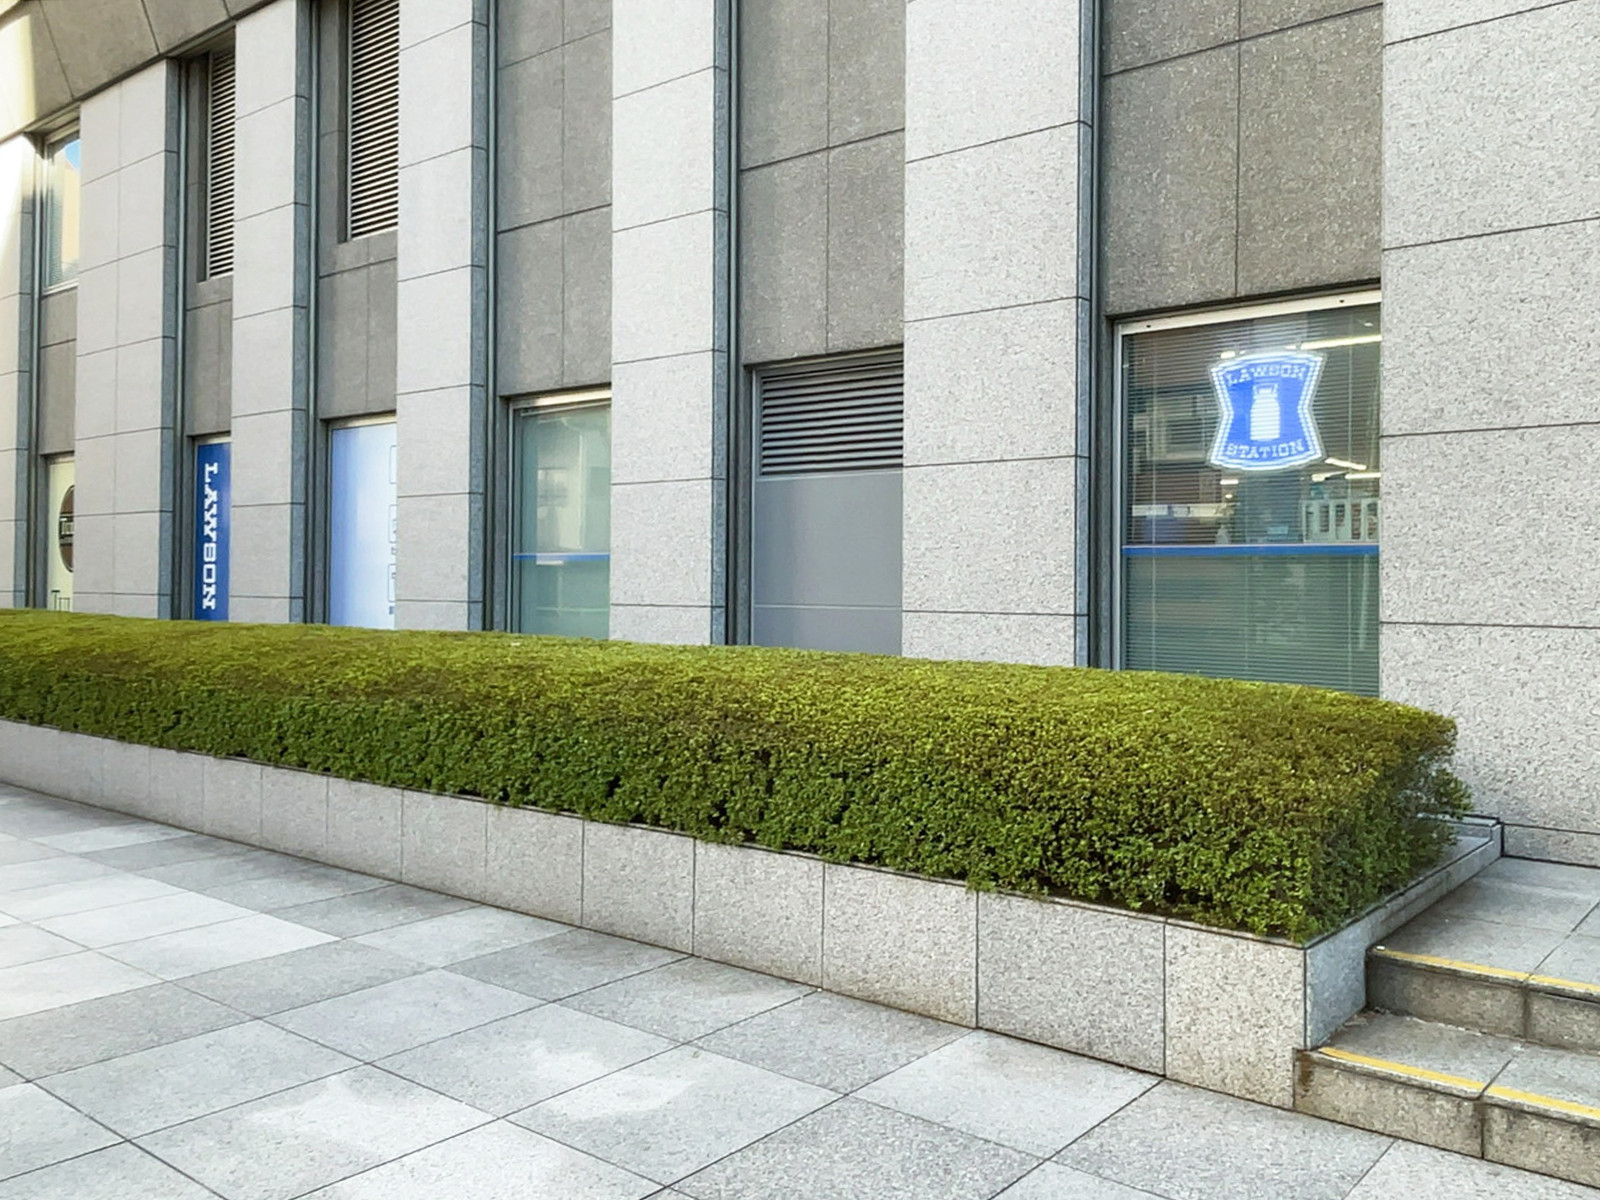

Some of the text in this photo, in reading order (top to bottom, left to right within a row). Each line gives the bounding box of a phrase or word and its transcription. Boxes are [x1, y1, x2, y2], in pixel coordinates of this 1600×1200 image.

[1226, 364, 1306, 387] LAWSON
[1226, 440, 1304, 459] STATION
[203, 463, 218, 610] LAWSON
